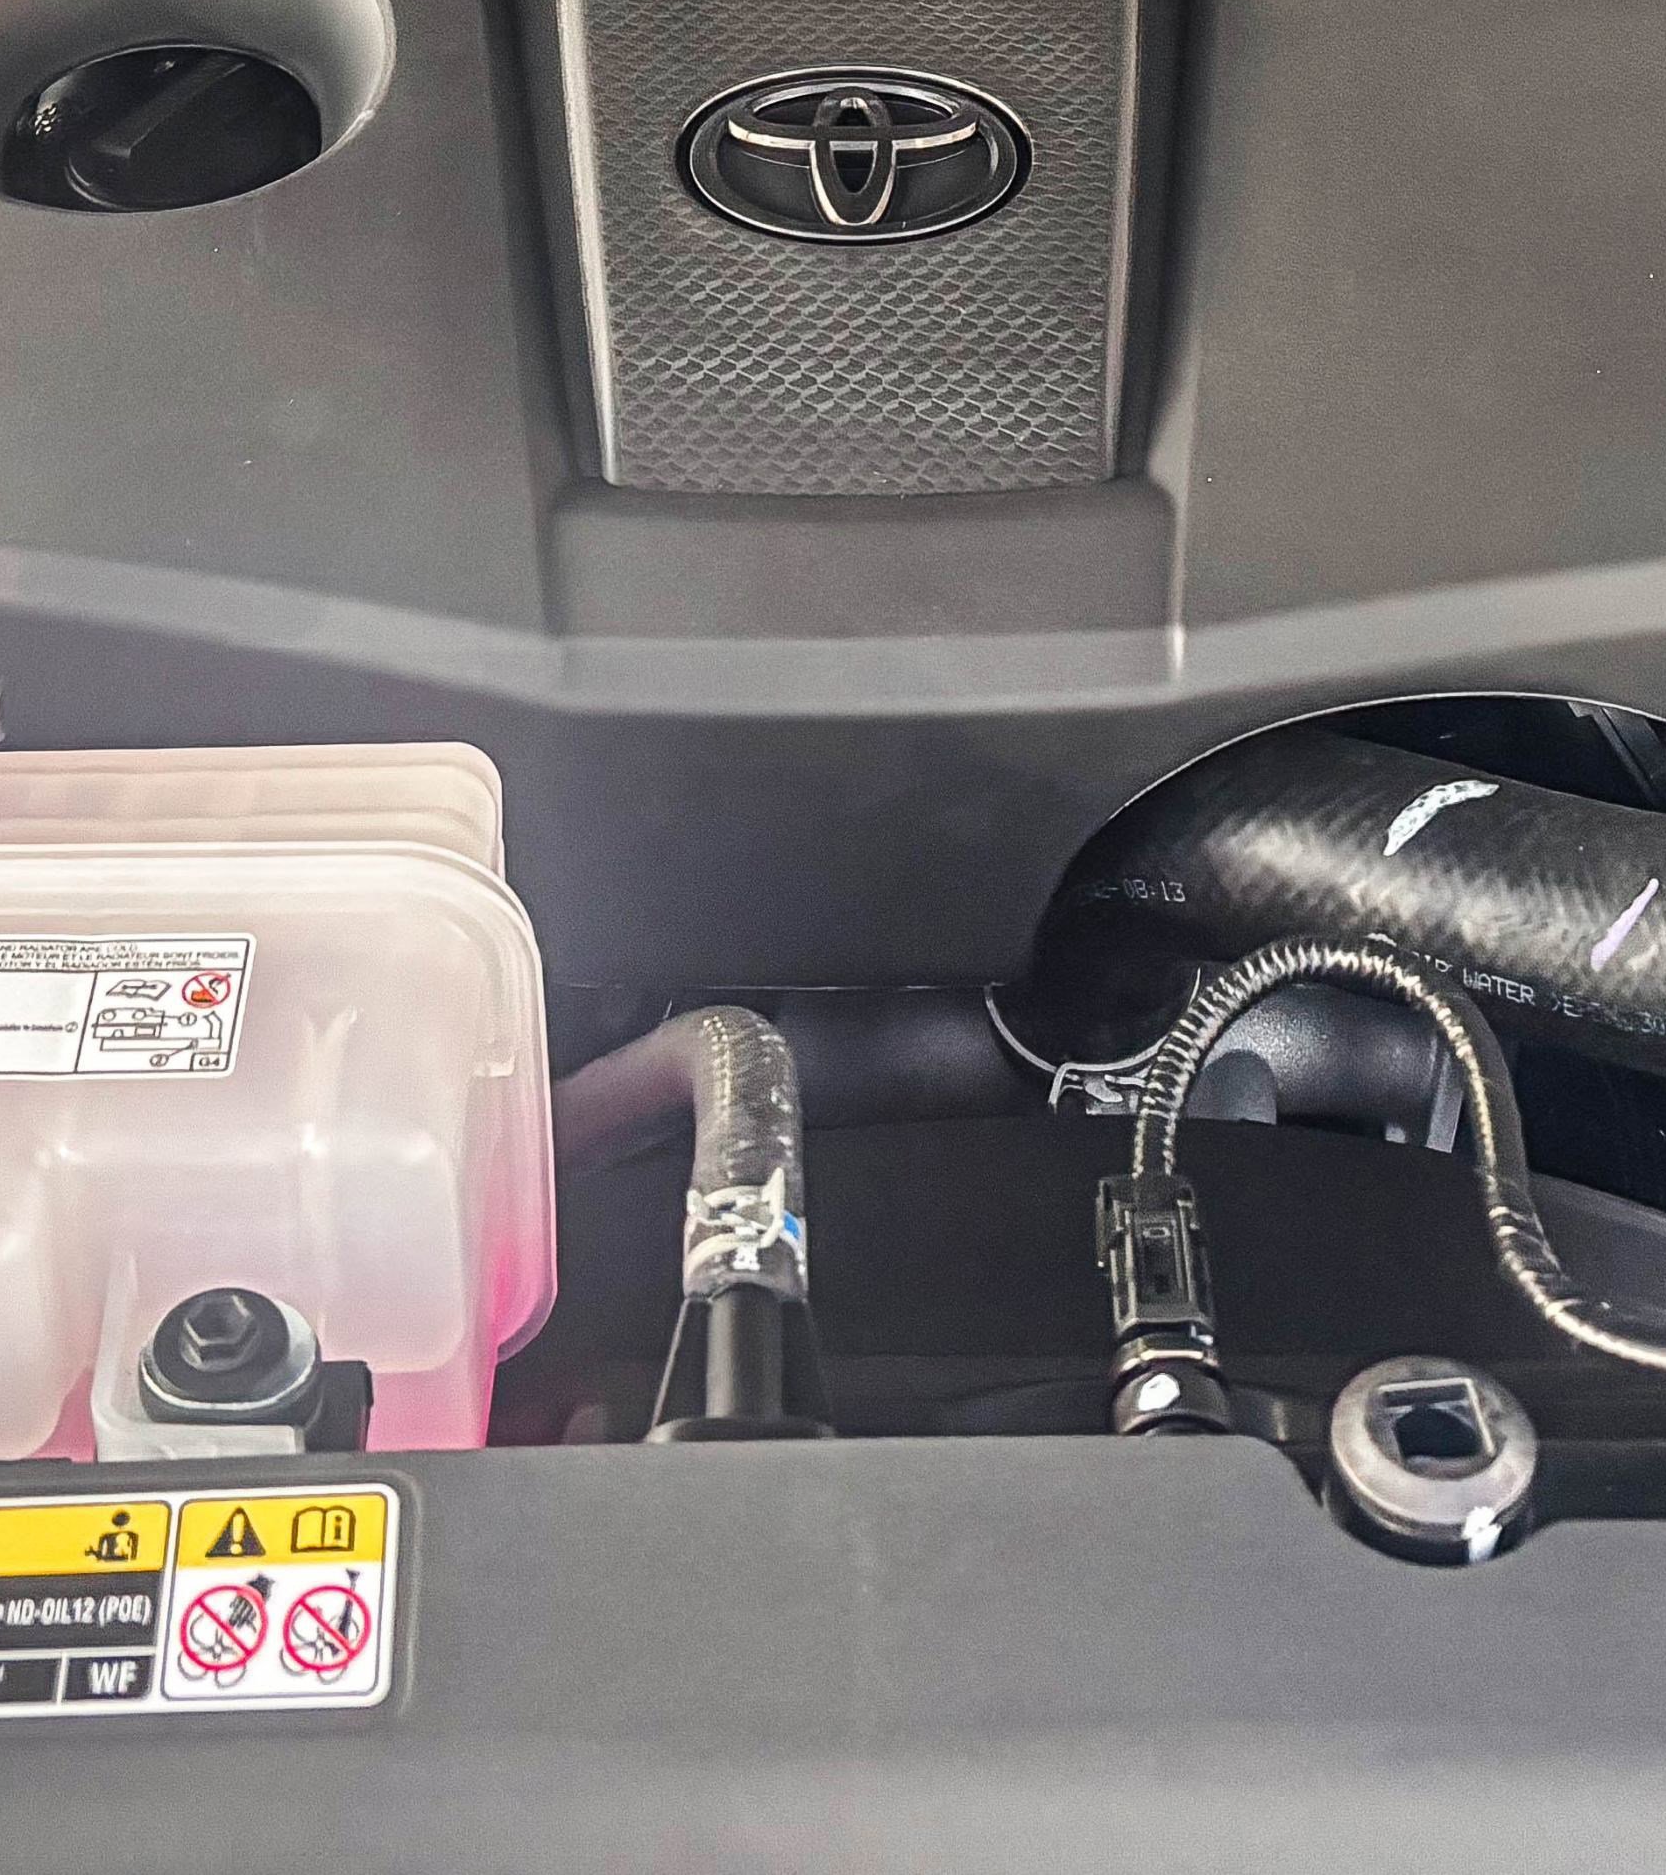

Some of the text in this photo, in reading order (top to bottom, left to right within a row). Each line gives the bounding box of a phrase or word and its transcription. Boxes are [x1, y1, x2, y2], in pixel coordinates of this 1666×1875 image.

[1463, 968, 1535, 1005] WATER
[99, 1595, 151, 1626] (POE)
[89, 1661, 137, 1695] WF
